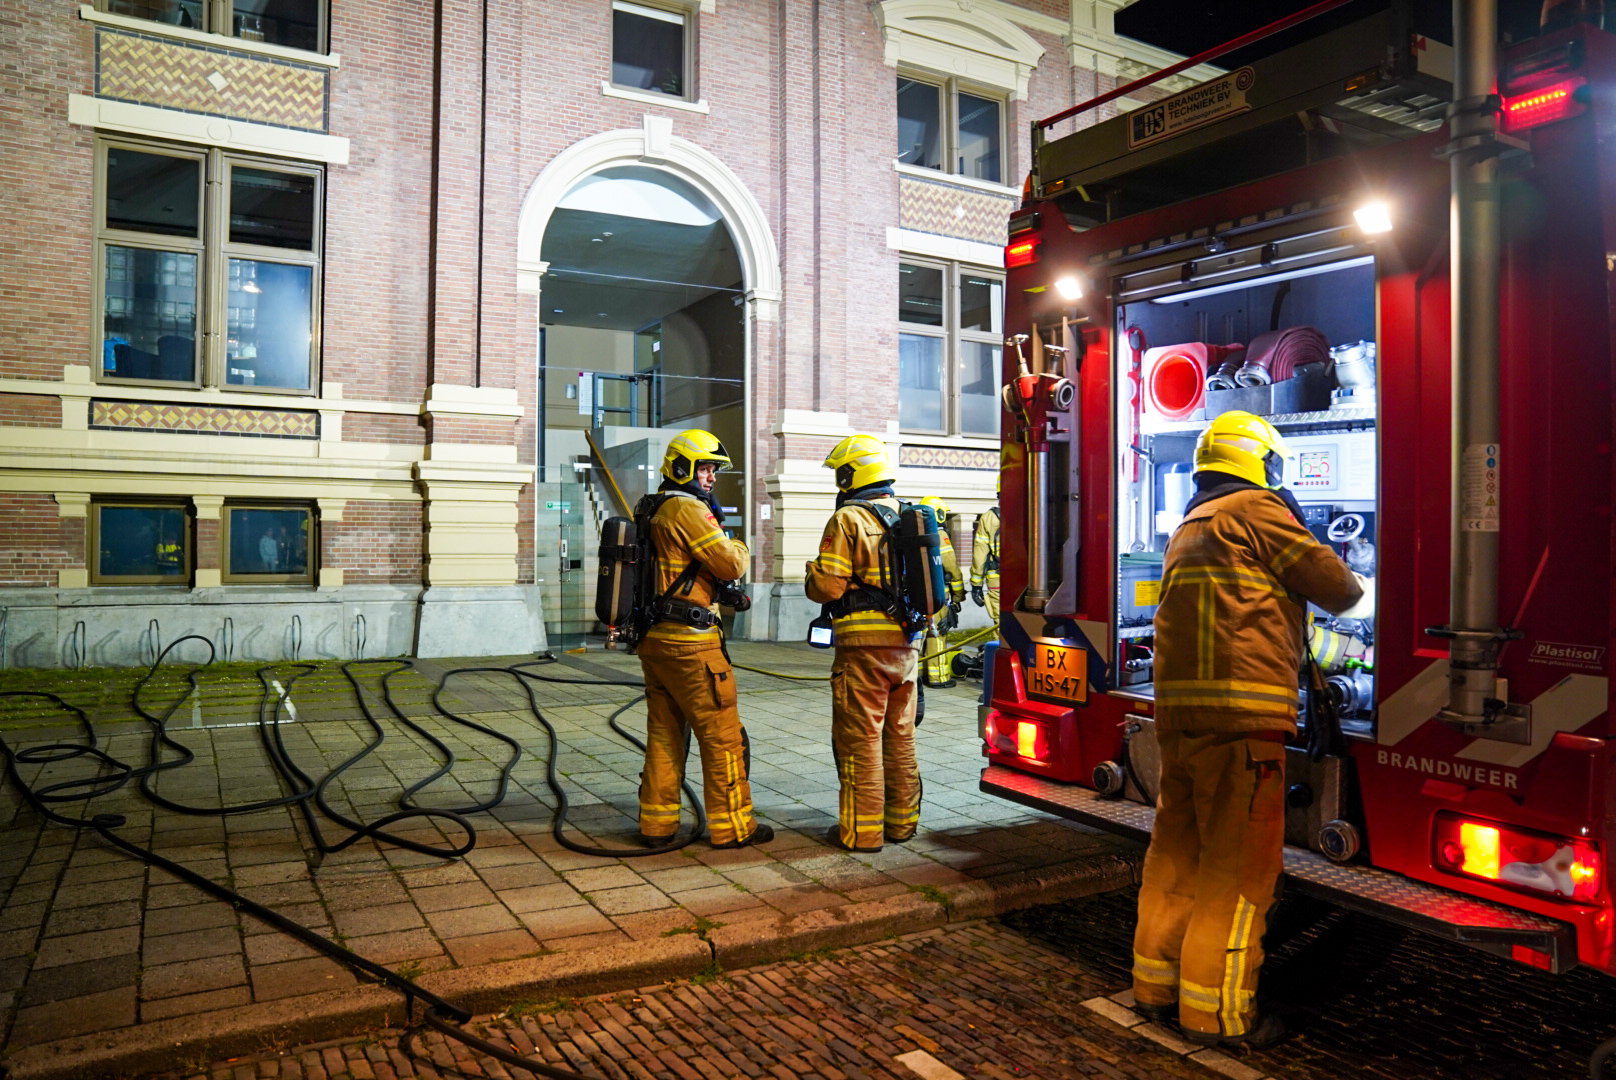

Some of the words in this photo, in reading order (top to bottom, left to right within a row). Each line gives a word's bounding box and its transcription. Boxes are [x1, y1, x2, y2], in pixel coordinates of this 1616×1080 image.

[1168, 81, 1232, 110] BRANDWEER-
[1169, 97, 1215, 120] TECHNIEK
[1218, 90, 1231, 102] BV
[1047, 649, 1067, 671] BX
[1536, 644, 1598, 661] Plastisol
[1034, 672, 1080, 697] HS-47
[1377, 750, 1518, 789] BRANDWEER
